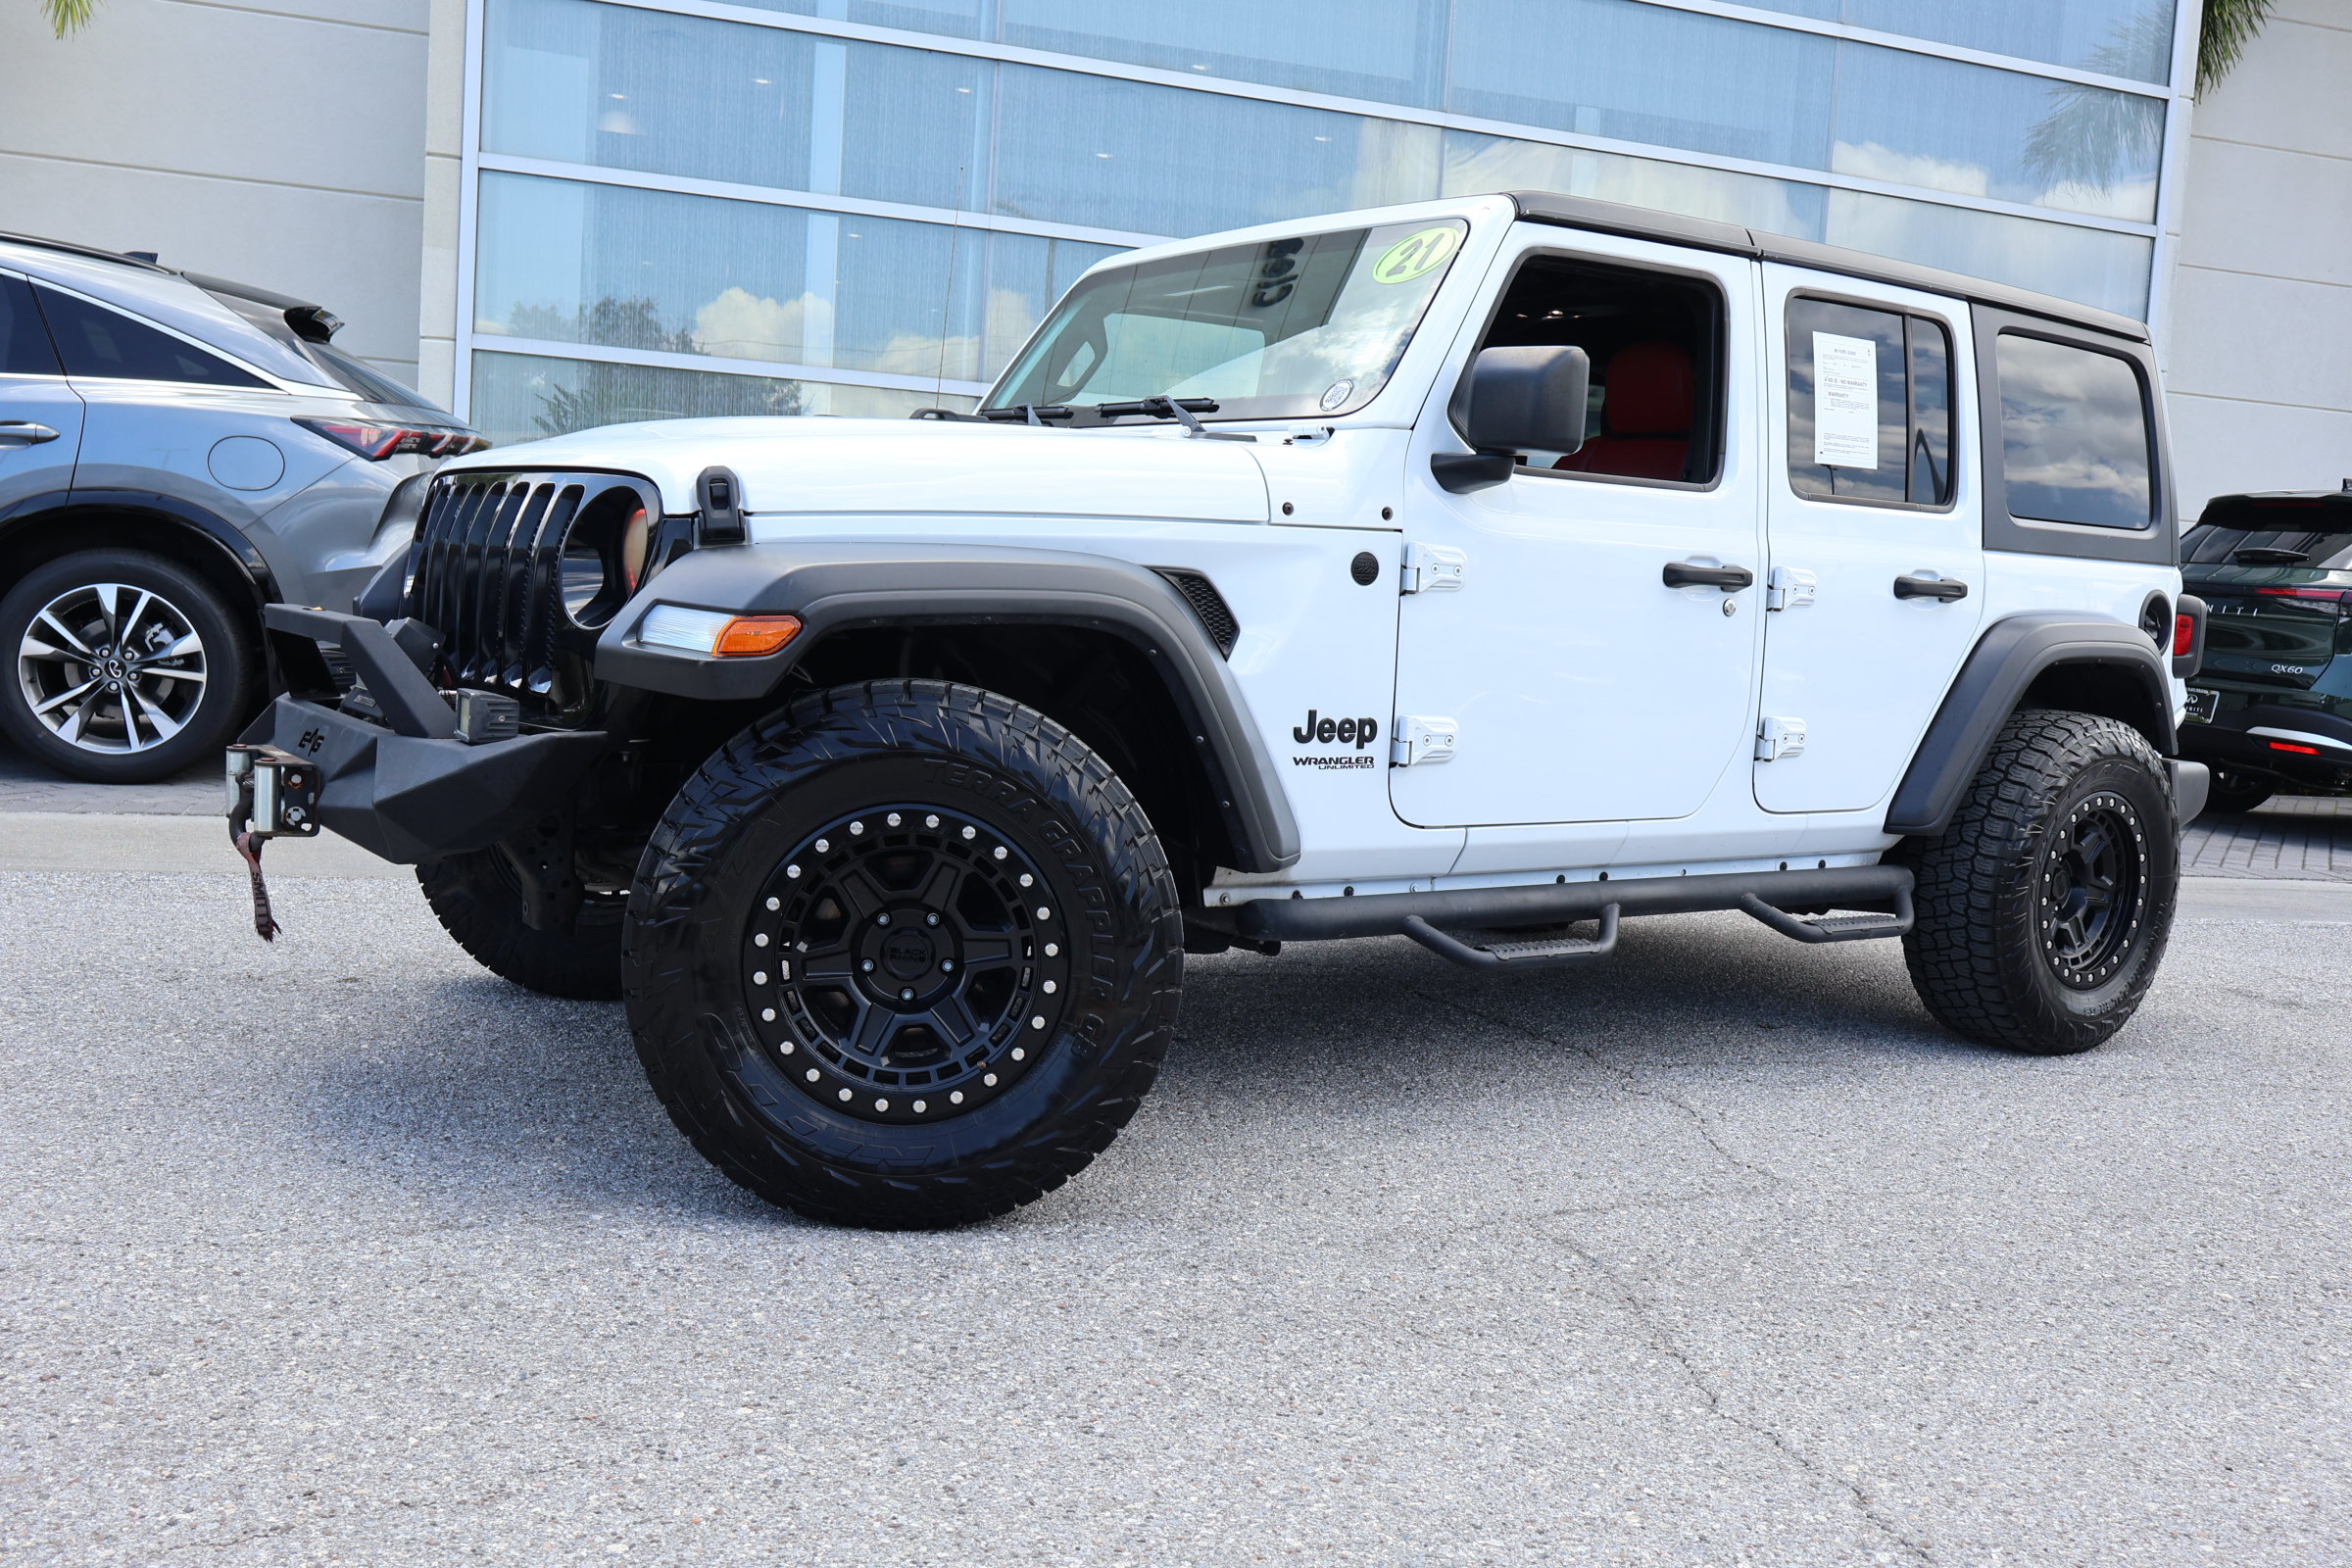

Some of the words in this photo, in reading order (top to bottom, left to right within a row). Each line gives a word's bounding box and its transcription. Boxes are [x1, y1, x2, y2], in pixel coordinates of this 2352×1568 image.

[1385, 232, 1446, 277] 21
[2206, 604, 2258, 616] NITI
[2271, 664, 2304, 674] QX60
[1293, 709, 1378, 750] Jeep
[1293, 756, 1375, 765] WRANGLER
[923, 758, 1037, 816] TERRA
